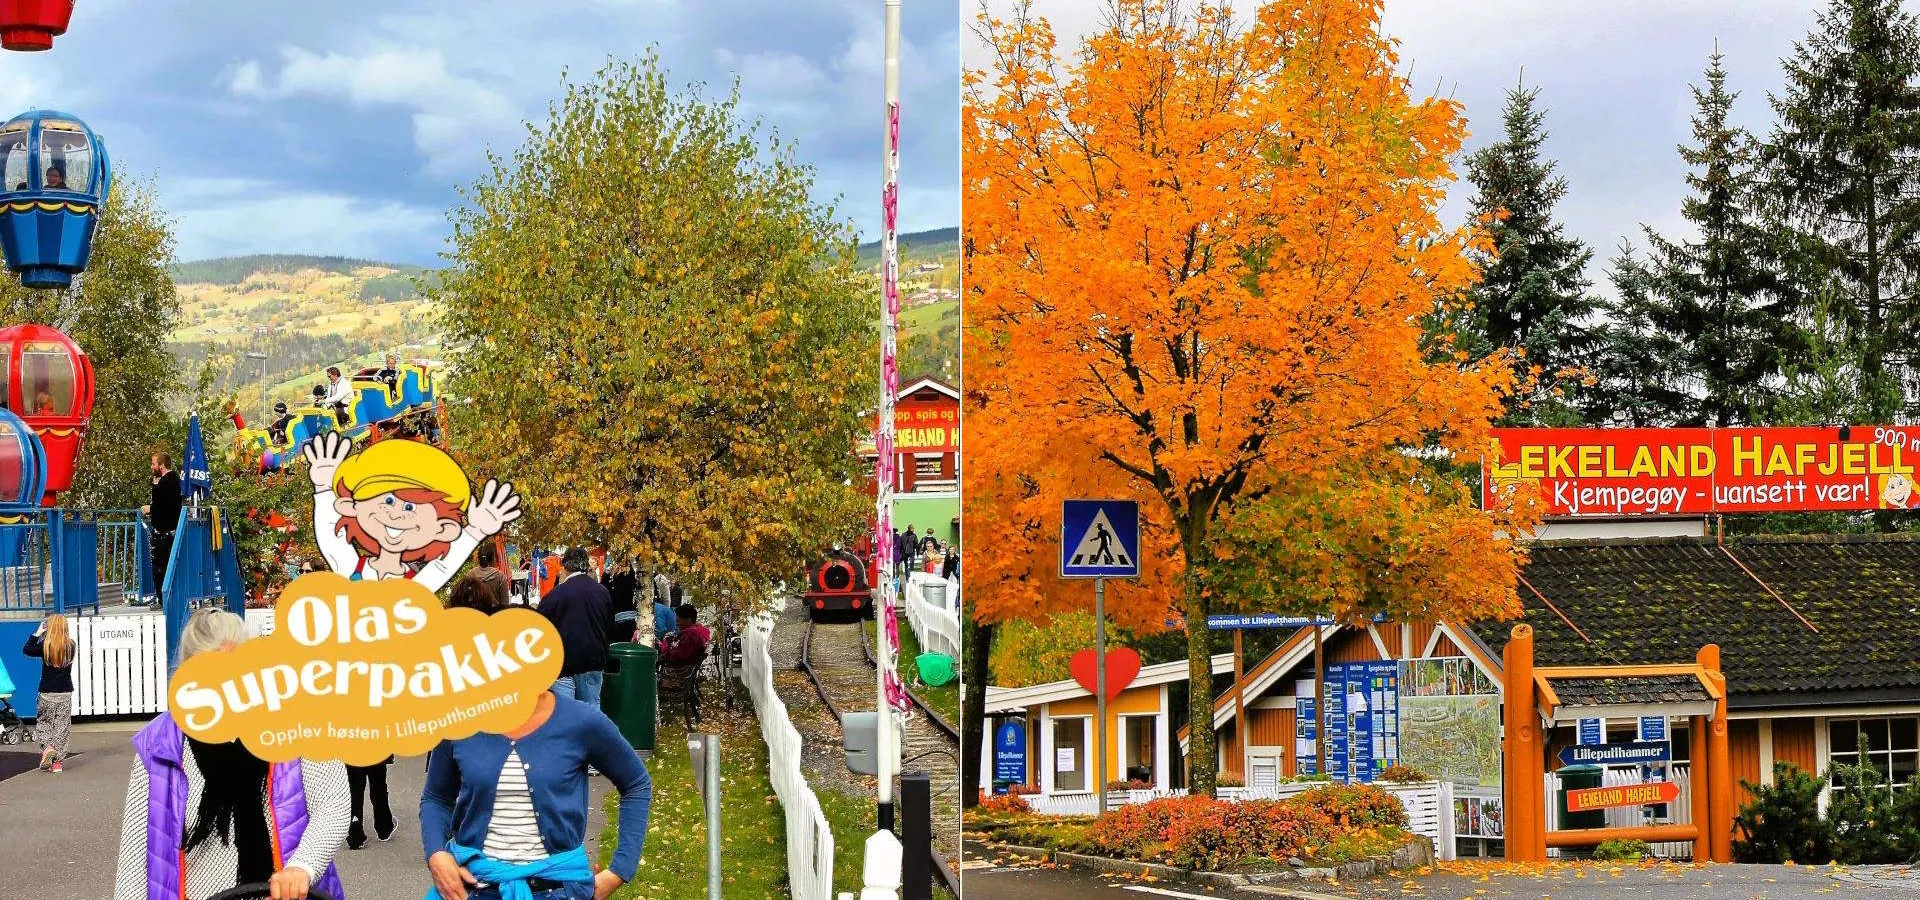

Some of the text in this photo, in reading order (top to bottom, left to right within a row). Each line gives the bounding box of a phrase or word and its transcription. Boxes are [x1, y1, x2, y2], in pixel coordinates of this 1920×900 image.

[916, 409, 938, 422] spis
[940, 410, 954, 421] og
[893, 427, 946, 448] EKELAND
[1874, 427, 1907, 448] 900
[1490, 435, 1914, 479] LEKELAND HAFJELL
[1554, 480, 1688, 513] Kjempegøy
[1715, 479, 1808, 504] uansett
[1814, 475, 1870, 502] vær!
[100, 629, 134, 640] UTGANG
[1573, 746, 1663, 761] Lilleputthammer
[1578, 789, 1623, 808] LEKELAND
